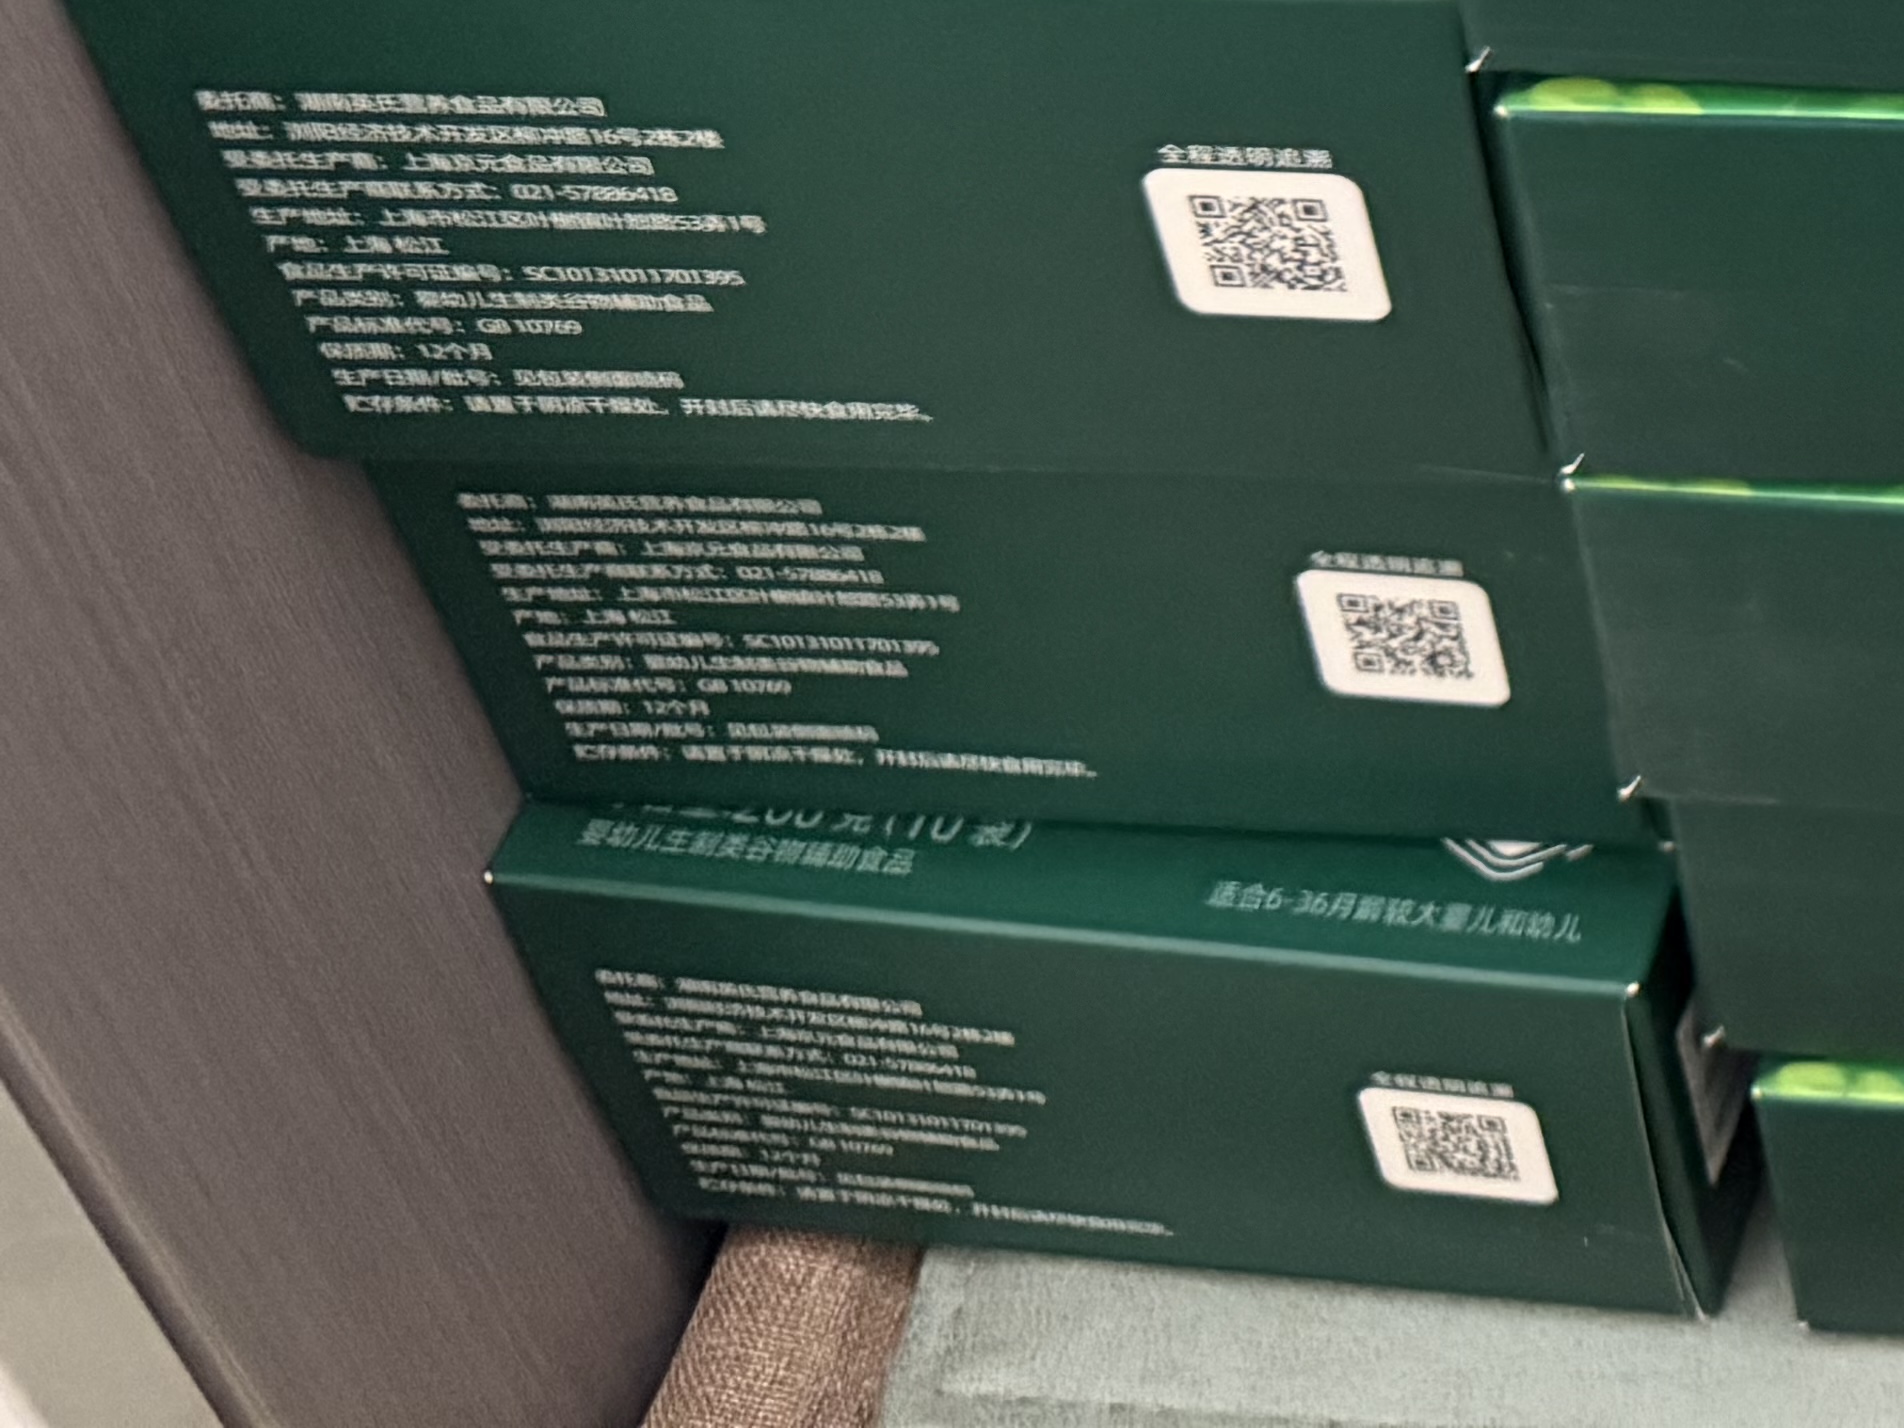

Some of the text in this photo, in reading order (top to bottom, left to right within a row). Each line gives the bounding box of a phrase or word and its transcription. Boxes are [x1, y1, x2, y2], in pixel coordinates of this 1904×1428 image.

[1156, 143, 1335, 169] 全程透明追溯
[576, 818, 916, 877] 婴幼儿生制类谷物辅助食品
